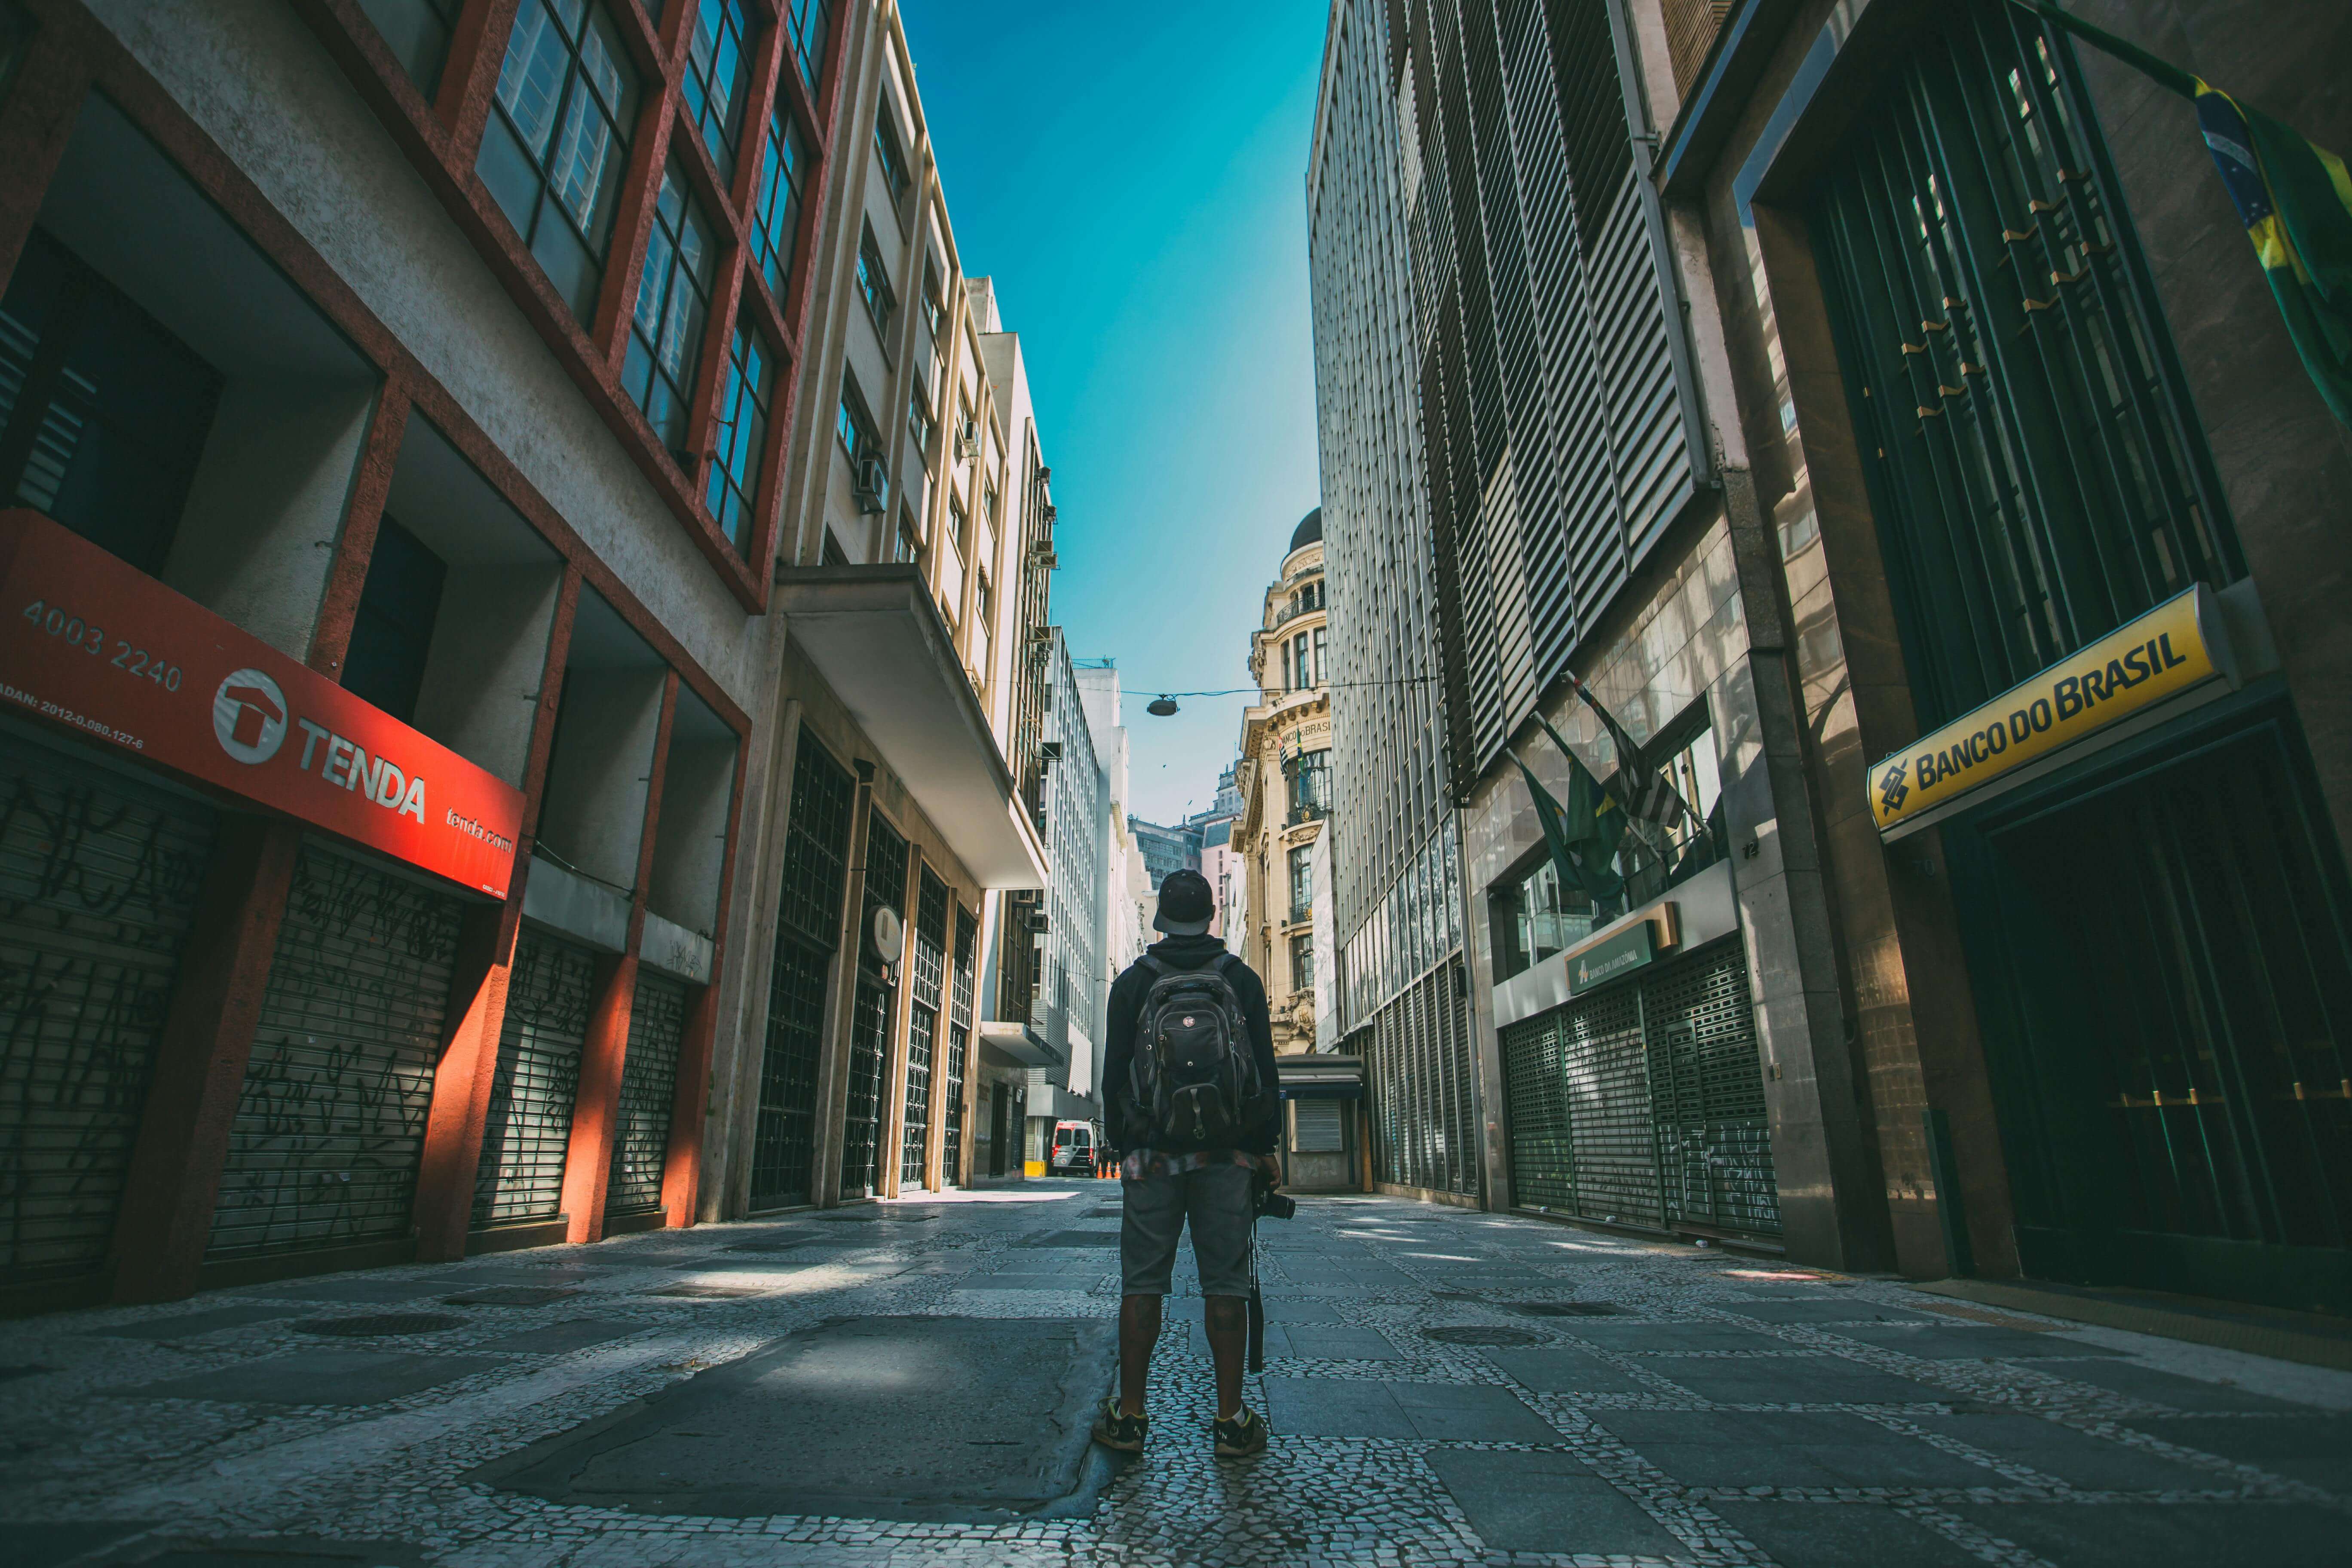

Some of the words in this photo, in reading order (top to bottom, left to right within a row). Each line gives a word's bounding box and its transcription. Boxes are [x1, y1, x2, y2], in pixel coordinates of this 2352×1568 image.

[23, 600, 104, 655] 4003
[111, 640, 182, 692] 2240
[40, 701, 144, 749] 2012-0.080.127-6
[1305, 722, 1330, 735] BRASI
[1916, 722, 2007, 791] BANCO
[2009, 698, 2052, 744] DO
[2054, 633, 2186, 722] BRASIL
[299, 717, 425, 824] TENDA
[446, 807, 512, 853] tenda.com
[1589, 965, 1604, 980] BANCO
[1605, 962, 1612, 973] DA
